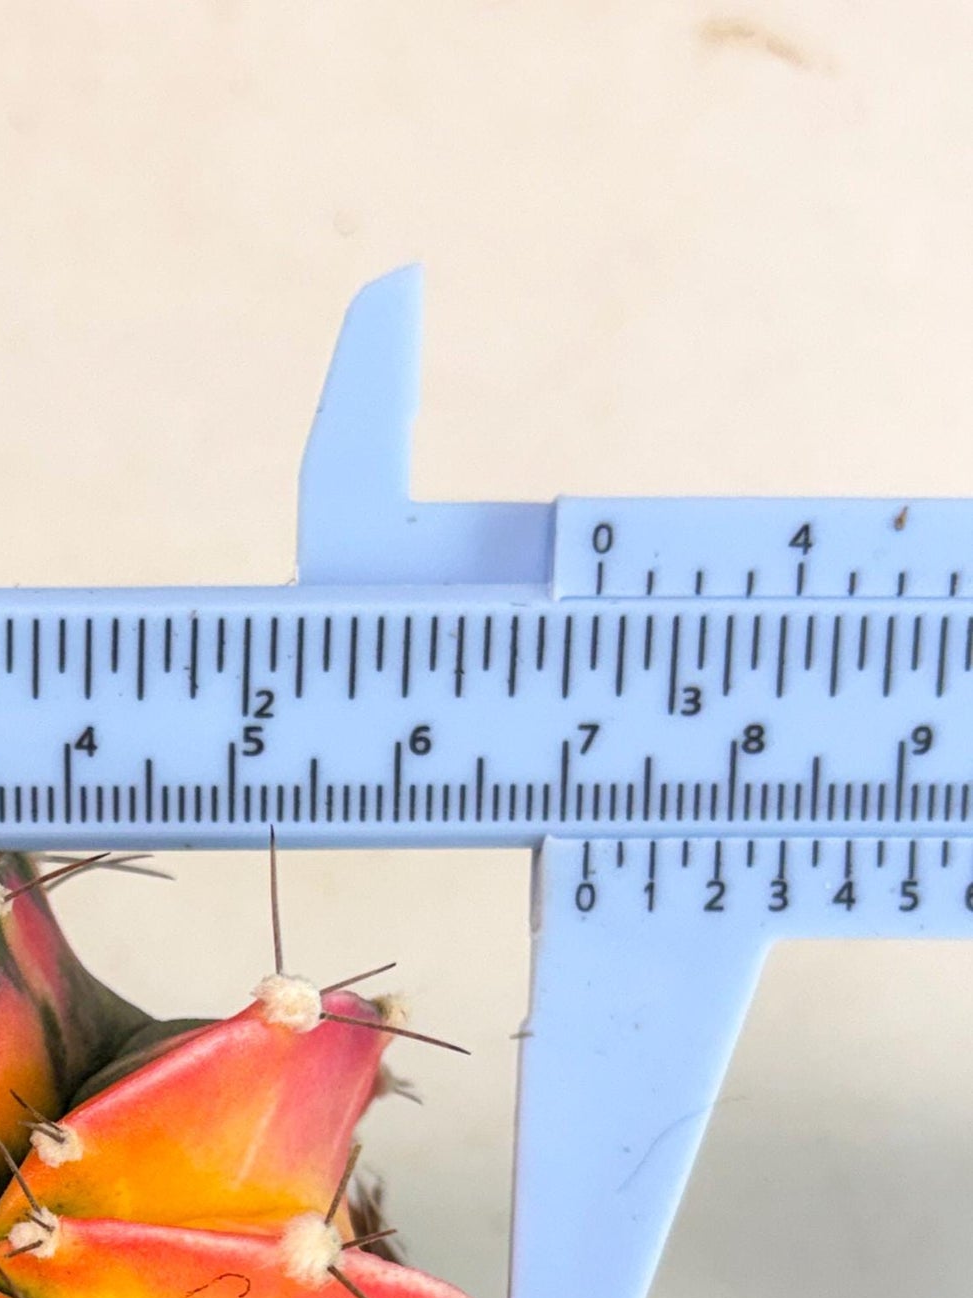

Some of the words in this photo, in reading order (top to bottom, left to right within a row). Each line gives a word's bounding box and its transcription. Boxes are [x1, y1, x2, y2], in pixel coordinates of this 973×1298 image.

[592, 523, 613, 554] 0
[789, 524, 812, 555] 4
[254, 690, 274, 719] 2
[681, 687, 701, 716] 3
[74, 726, 97, 757] 4
[242, 726, 264, 757] 5
[409, 725, 432, 756] 6
[577, 724, 600, 755] 7
[742, 724, 765, 755] 8
[911, 726, 933, 755] 9
[575, 883, 596, 912] 0
[643, 882, 654, 912] 1
[704, 881, 725, 912] 2
[768, 881, 789, 911] 3
[832, 881, 856, 912] 4
[899, 881, 919, 912] 5
